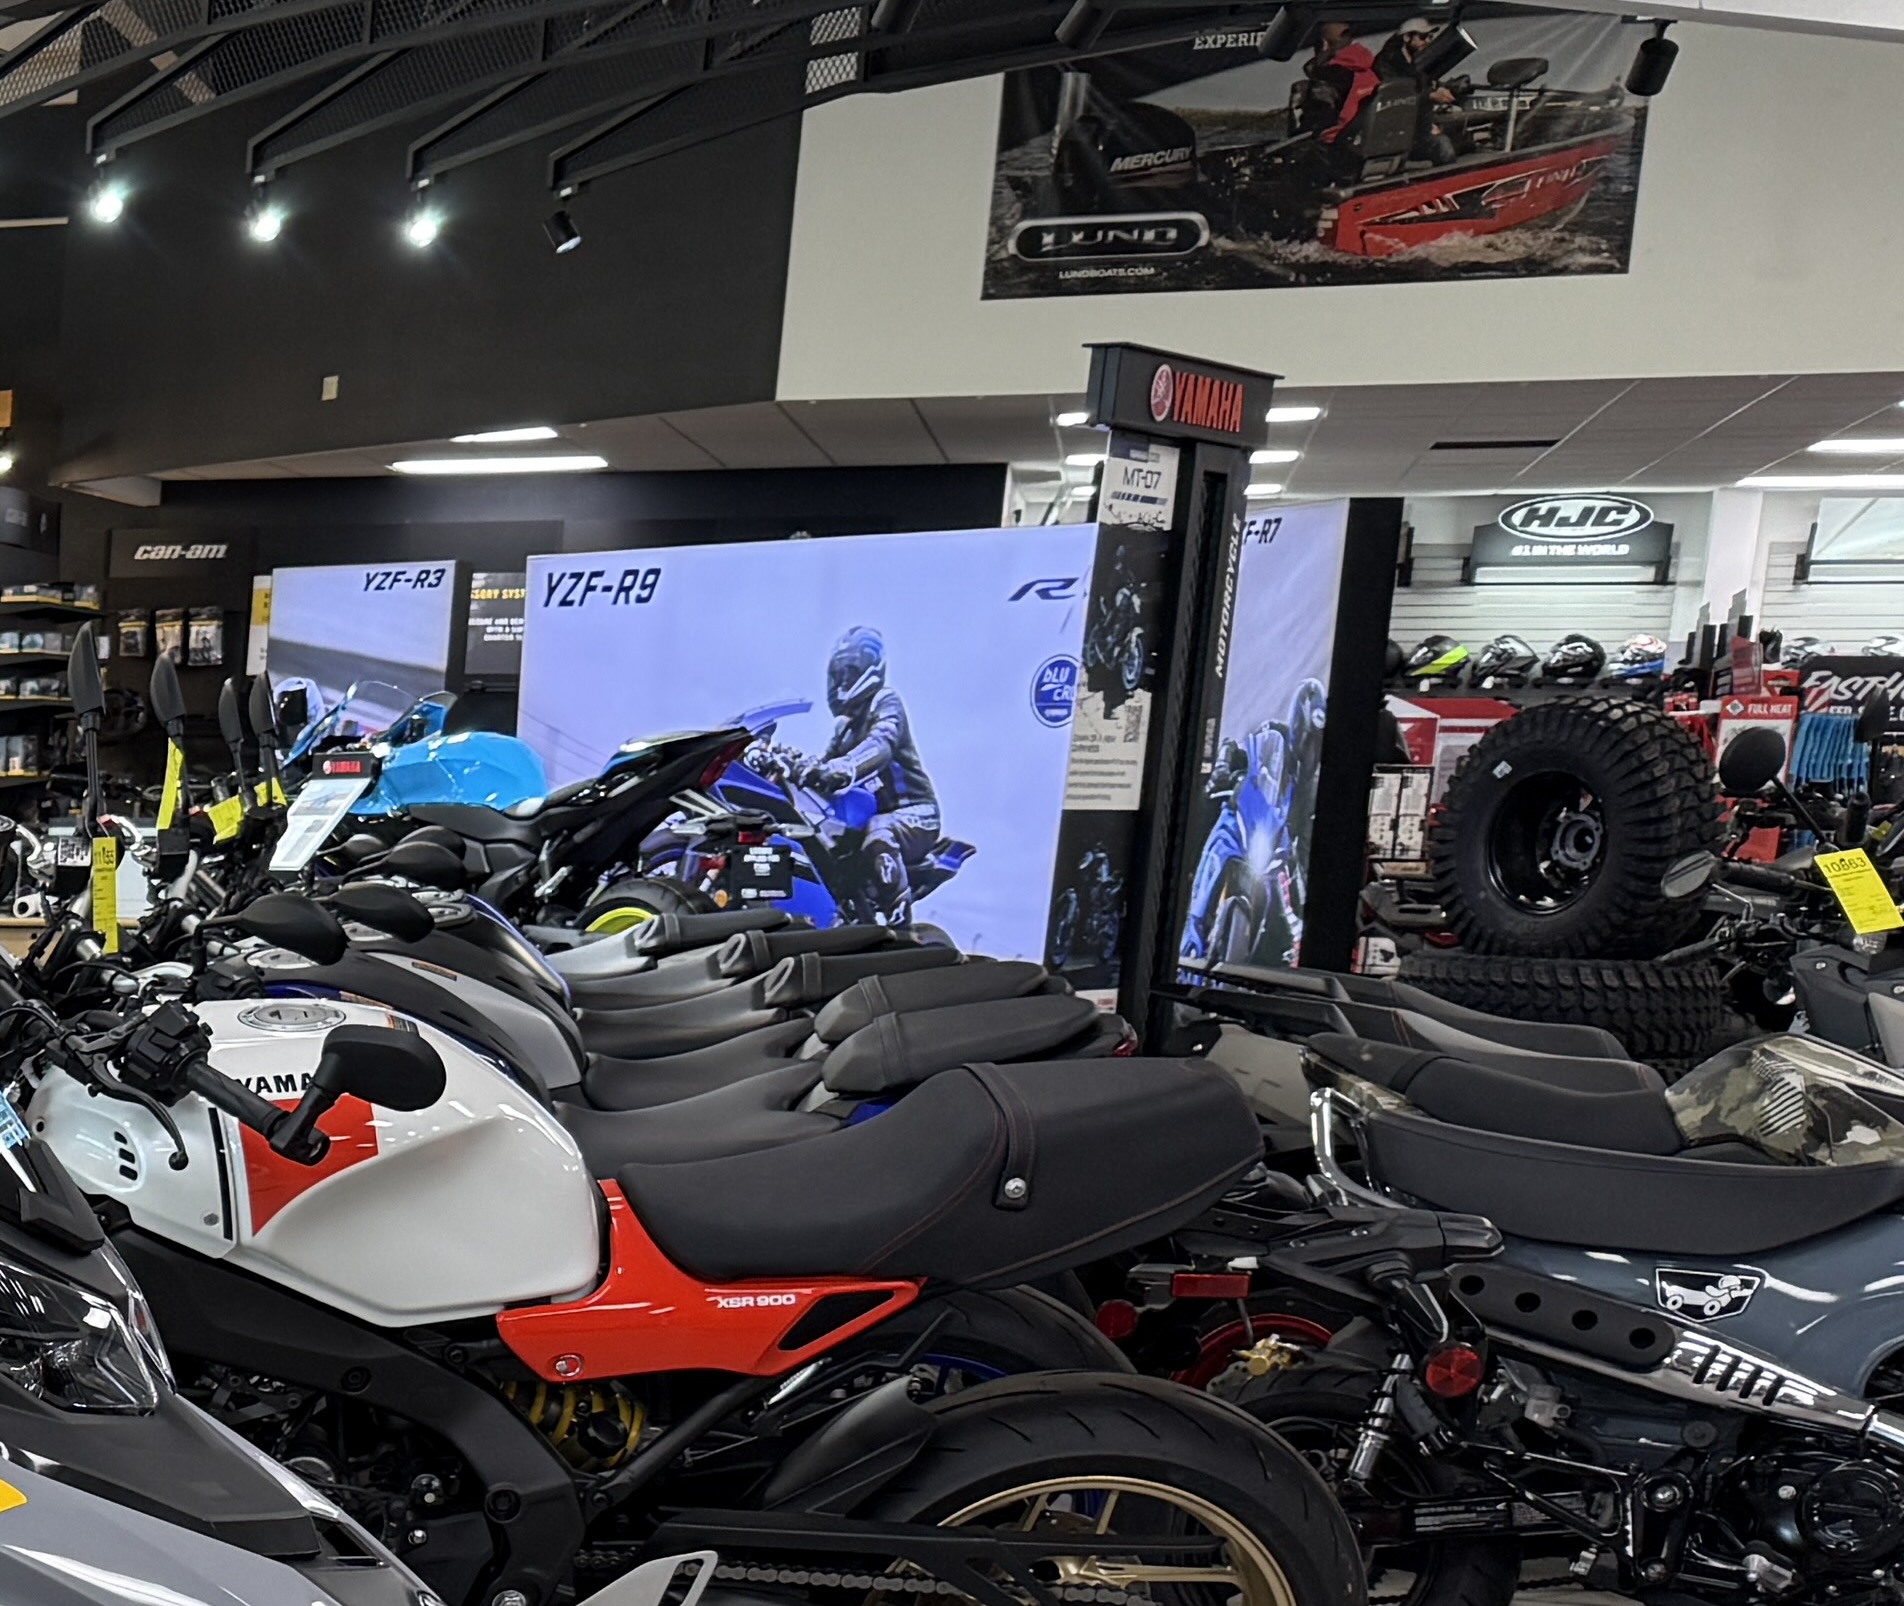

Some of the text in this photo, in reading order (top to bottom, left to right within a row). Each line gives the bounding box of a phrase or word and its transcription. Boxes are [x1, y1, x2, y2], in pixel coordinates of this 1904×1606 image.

[1040, 228, 1177, 252] LUND
[1059, 266, 1156, 280] LUNDBOATS.COM
[1174, 370, 1243, 432] YAMAHA
[1122, 466, 1162, 490] MT-07
[1516, 506, 1635, 529] HJC
[134, 544, 228, 561] can-am
[1578, 544, 1630, 556] WORLD
[364, 568, 446, 592] YZF-R3
[542, 567, 662, 608] YZF-R9
[1215, 513, 1243, 678] MOTORCYCLE
[717, 1294, 796, 1308] XSR 900
